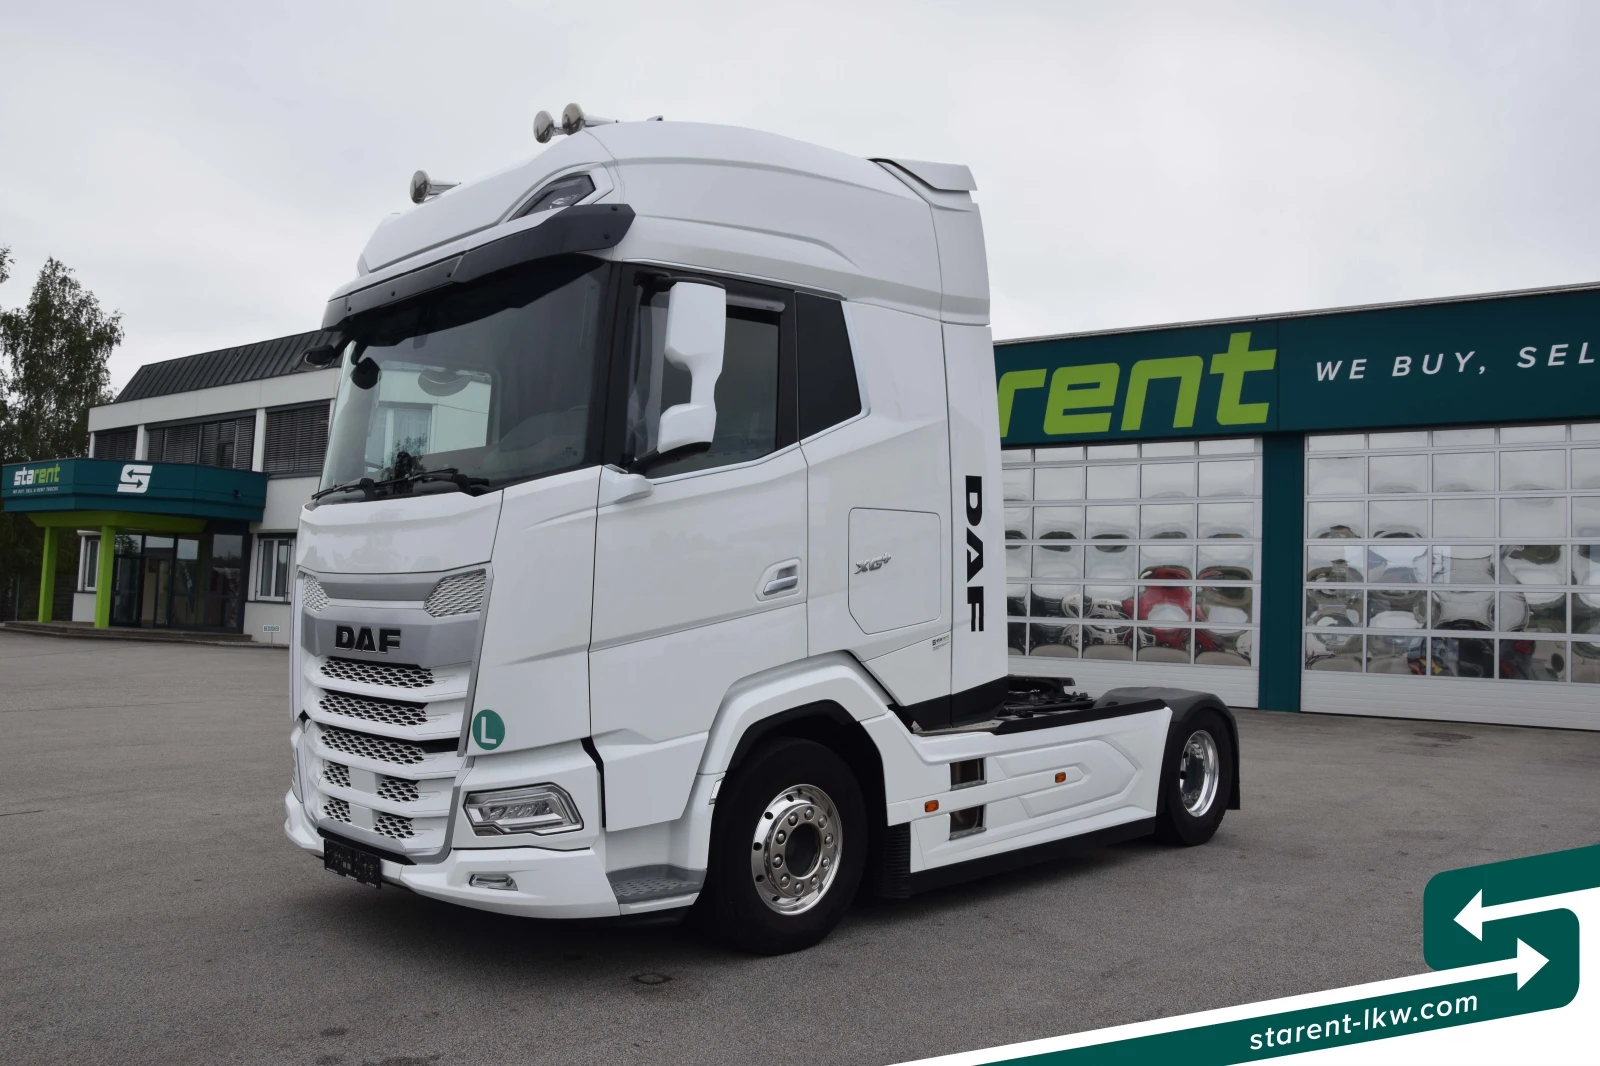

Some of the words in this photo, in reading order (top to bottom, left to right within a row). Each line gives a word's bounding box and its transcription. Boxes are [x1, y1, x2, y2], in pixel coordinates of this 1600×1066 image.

[1316, 359, 1367, 382] WE
[1392, 351, 1487, 377] BUY,
[1516, 342, 1595, 368] SEL
[997, 332, 1277, 437] rent
[13, 463, 60, 486] starent
[965, 475, 985, 632] DAF
[334, 625, 402, 655] DAF
[480, 716, 497, 745] L
